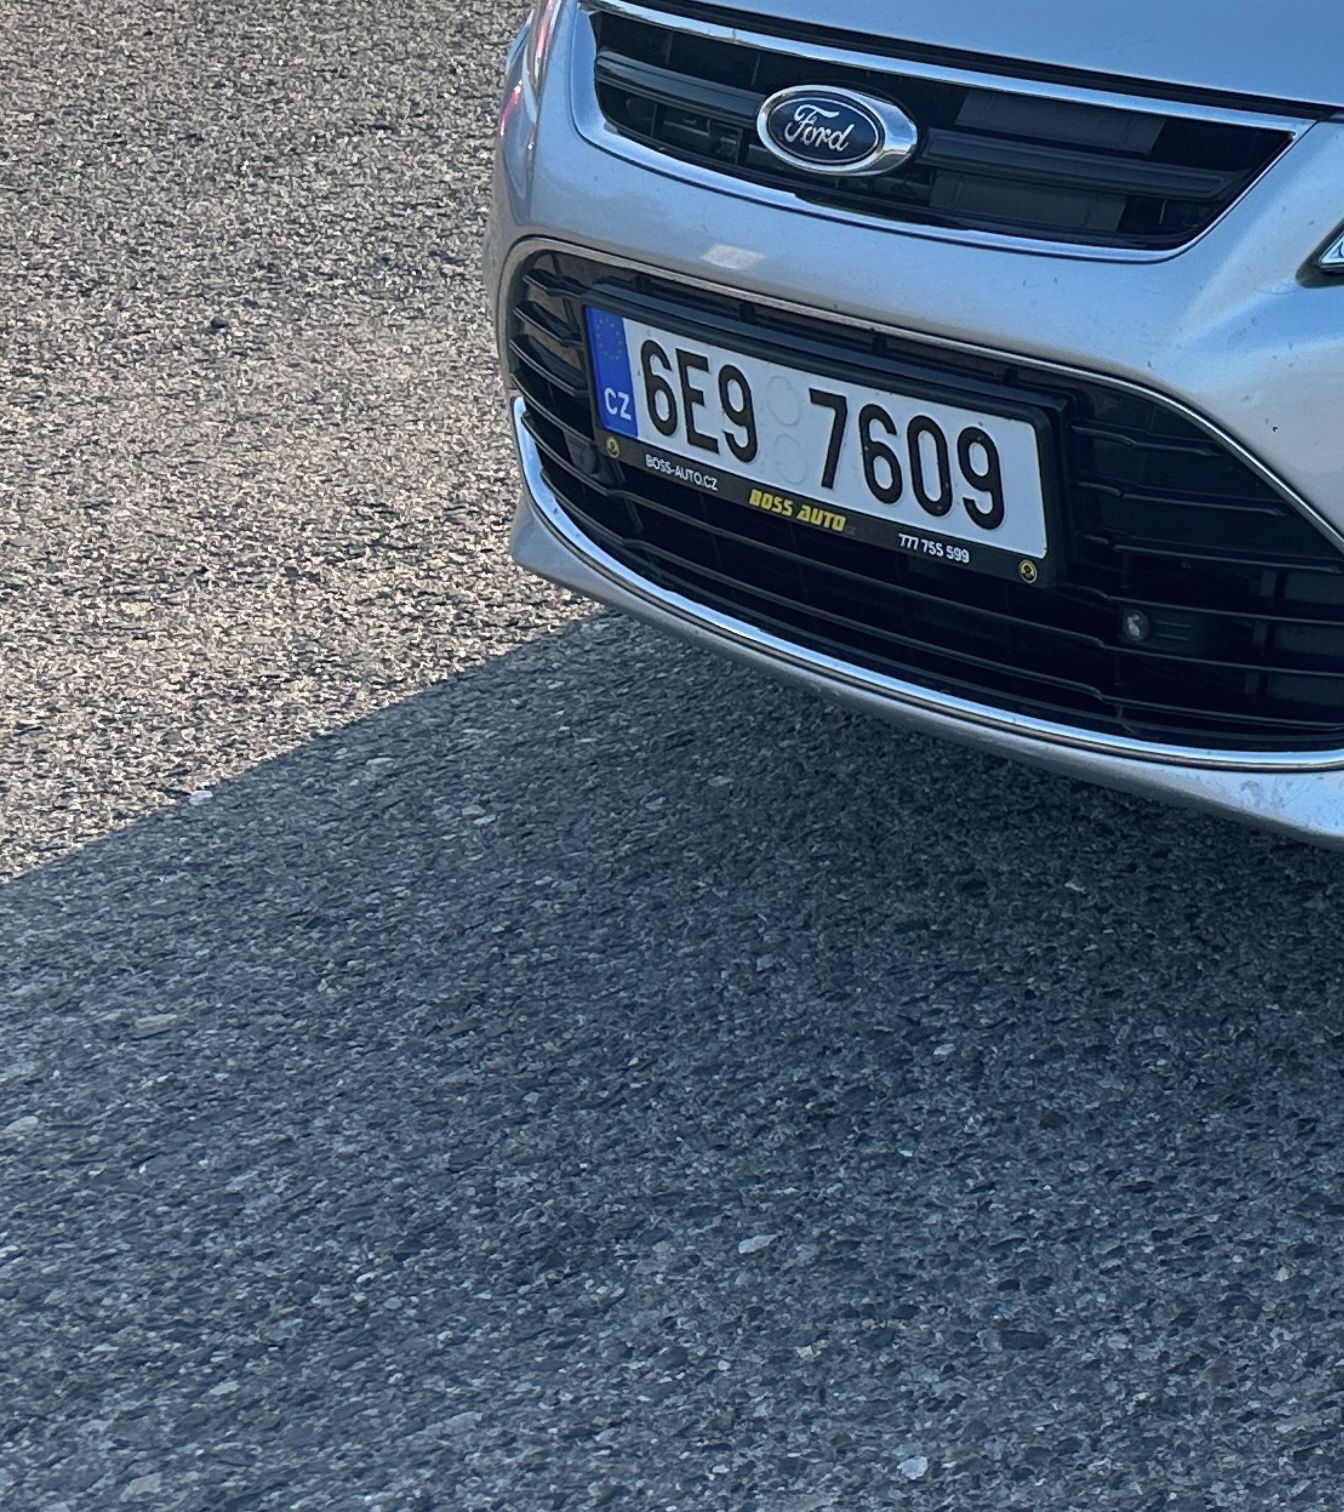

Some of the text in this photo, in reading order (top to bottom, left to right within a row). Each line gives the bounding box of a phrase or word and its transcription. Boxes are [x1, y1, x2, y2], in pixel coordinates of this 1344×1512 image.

[784, 104, 855, 152] Ford
[604, 339, 1005, 530] CZ 6E9 7609
[645, 454, 719, 491] BOSS-AUTO.CZ
[749, 489, 846, 532] BOSS AUTO
[899, 533, 970, 564] 777 755 599
